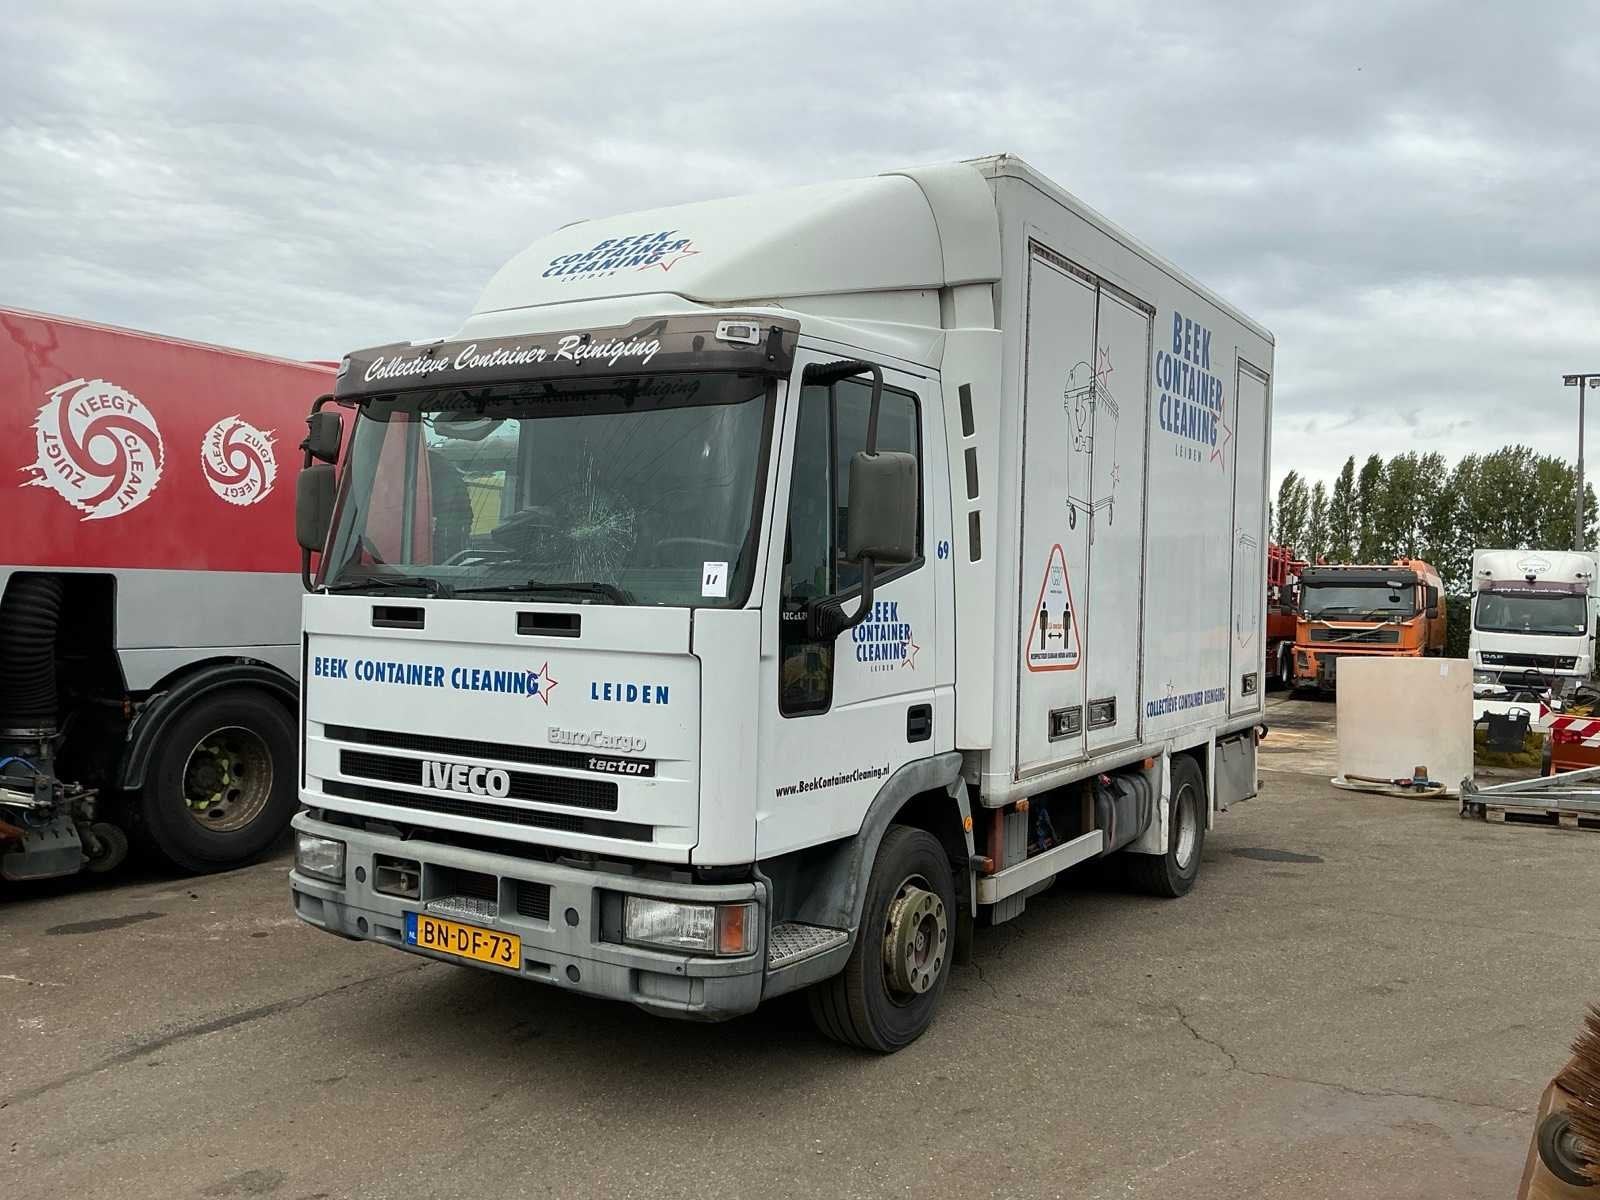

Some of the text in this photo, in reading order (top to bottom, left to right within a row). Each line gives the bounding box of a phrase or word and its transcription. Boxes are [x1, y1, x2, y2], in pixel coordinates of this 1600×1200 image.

[549, 239, 691, 267] CONTAINER
[591, 230, 680, 251] BEEK
[542, 251, 666, 278] CLEANING
[1173, 311, 1212, 370] BEEK
[364, 334, 661, 382] Collectieve Container Reiniging
[1156, 351, 1223, 412] CONTAINER
[75, 394, 138, 418] VEEGT
[1159, 394, 1218, 446] CLEANING
[43, 430, 87, 489] ZUIGT
[212, 423, 228, 474] CLEANT
[243, 433, 273, 466] ZUIGT
[118, 434, 145, 510] CLEANT
[222, 477, 259, 498] VEEGT
[937, 541, 949, 560] 69
[852, 623, 911, 643] CONTAINER
[856, 641, 908, 662] CLEANING
[314, 656, 540, 694] BEEK CONTAINER CLEANING
[591, 682, 670, 705] LEIDEN
[548, 727, 647, 752] EuroCargo
[422, 760, 510, 798] IVECO
[588, 757, 650, 774] tector
[775, 763, 890, 798] www.BeekContainerCleaning.nl
[424, 920, 513, 962] BN-DF-73
